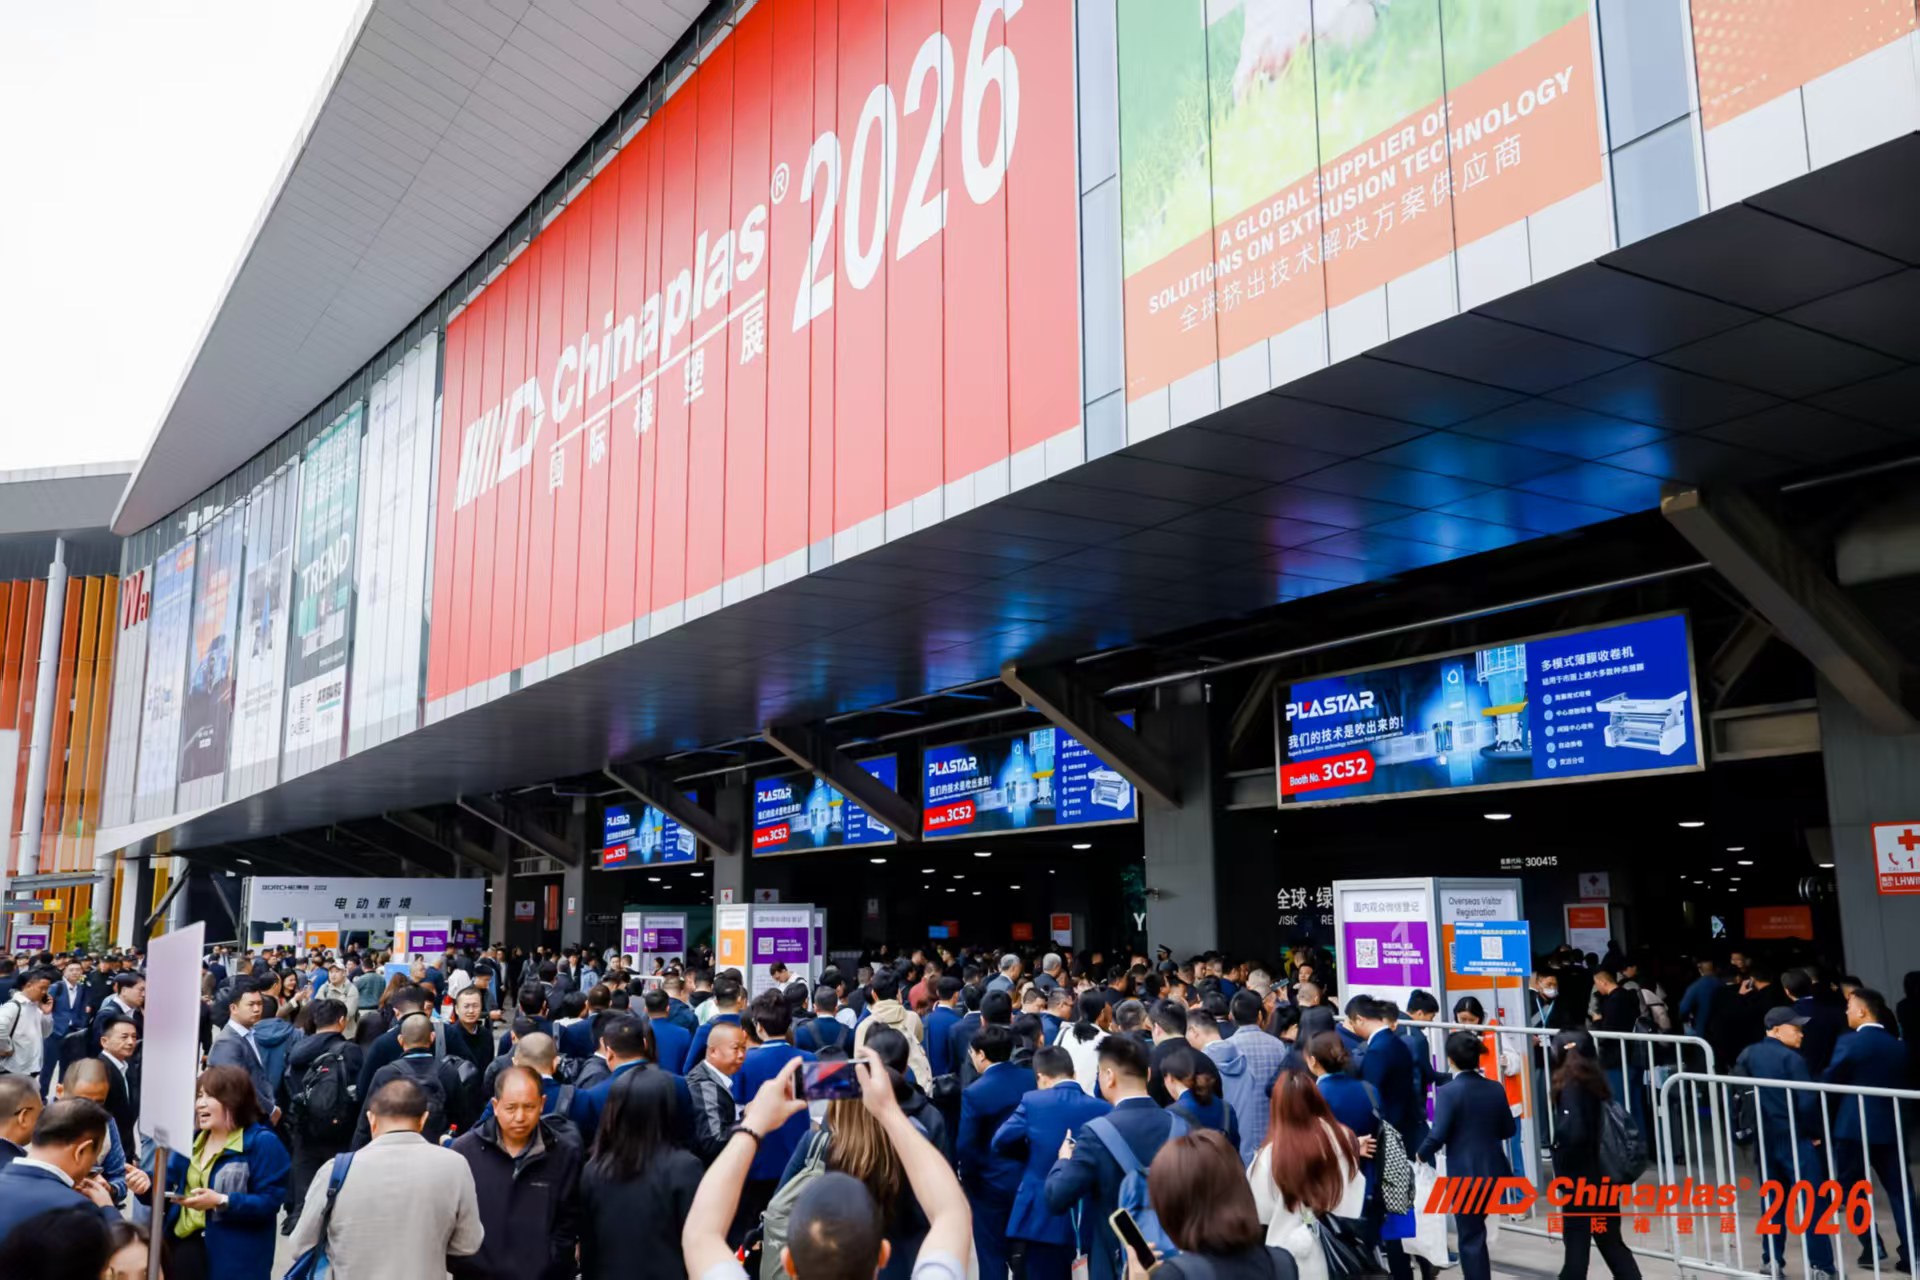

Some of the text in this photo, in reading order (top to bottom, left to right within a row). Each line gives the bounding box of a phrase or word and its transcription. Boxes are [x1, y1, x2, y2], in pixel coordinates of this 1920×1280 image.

[793, 0, 1023, 332] 2026
[1220, 102, 1453, 250] A GLOBAL SUPPLIER OF
[1149, 65, 1573, 314] SOLUTIONS ON EXTRUSION TECHNOLOGY
[1180, 134, 1521, 333] 全球挤出技术解决方案供应商
[302, 533, 350, 601] TREND
[1541, 646, 1634, 672] 多模式薄膜收卷机
[1285, 690, 1375, 721] PLASTAR
[928, 756, 977, 777] PLASTAR
[1290, 775, 1309, 786] Booth
[1322, 758, 1367, 781] 3C52
[757, 787, 792, 803] PLASTAR
[946, 805, 972, 822] 3C52
[770, 828, 787, 841] 3C52
[1525, 856, 1558, 867] 300415
[1277, 886, 1333, 909] 全球·绿
[1448, 896, 1503, 906] Overseas Visitor
[1321, 914, 1333, 926] RE
[1455, 908, 1497, 919] Registration
